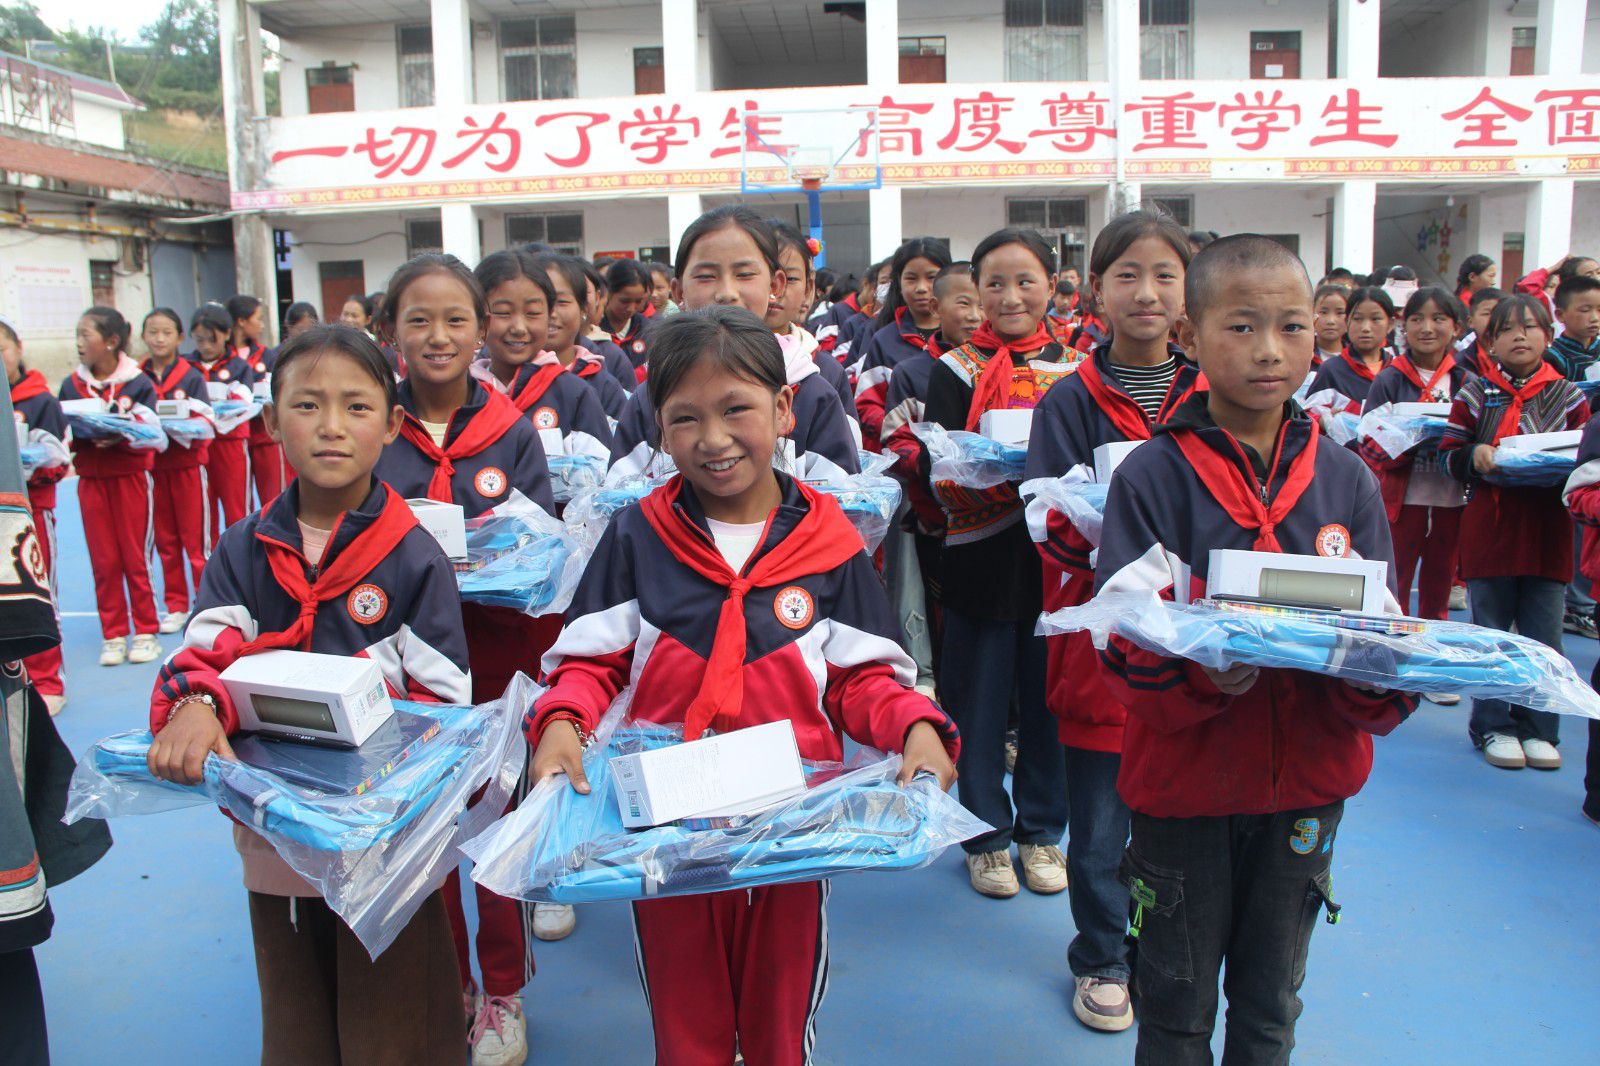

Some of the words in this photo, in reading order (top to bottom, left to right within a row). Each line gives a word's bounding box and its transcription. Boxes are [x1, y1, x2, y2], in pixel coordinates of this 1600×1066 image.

[271, 100, 797, 179] 一切为了学生
[848, 89, 1399, 157] 高度尊重学生
[1441, 86, 1600, 148] 全面
[1289, 817, 1320, 855] 3
